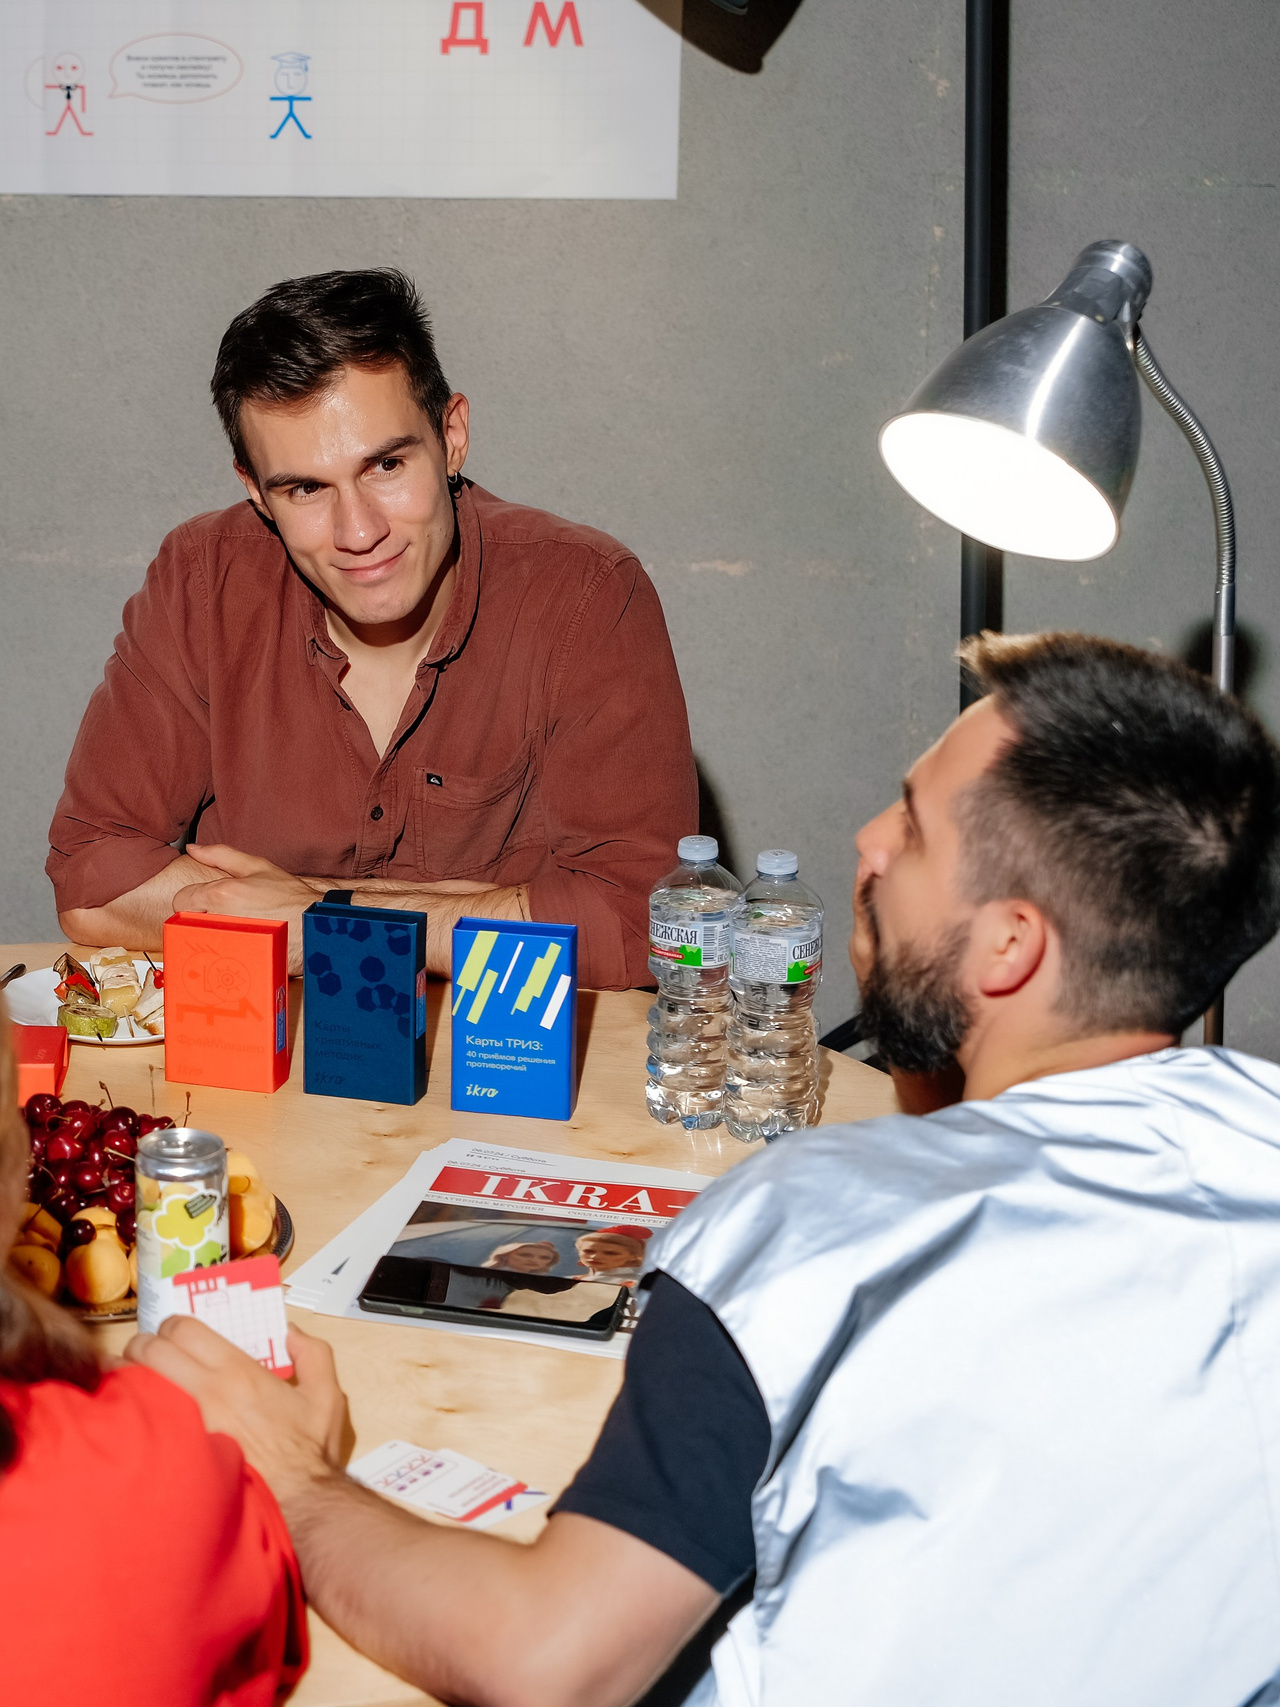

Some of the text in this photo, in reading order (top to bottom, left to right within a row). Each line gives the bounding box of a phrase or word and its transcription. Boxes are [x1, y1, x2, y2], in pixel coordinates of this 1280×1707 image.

[440, 1, 489, 55] Д
[792, 935, 822, 960] СЕНЕЖ
[314, 1020, 351, 1033] Карты
[314, 1036, 382, 1050] креативных
[465, 1034, 543, 1051] Карты ТРИЗ:
[314, 1049, 365, 1062] методик
[465, 1050, 556, 1065] 40 приёмов решения
[465, 1060, 527, 1072] противоречий
[314, 1070, 346, 1085] ikra
[465, 1084, 499, 1098] ikra
